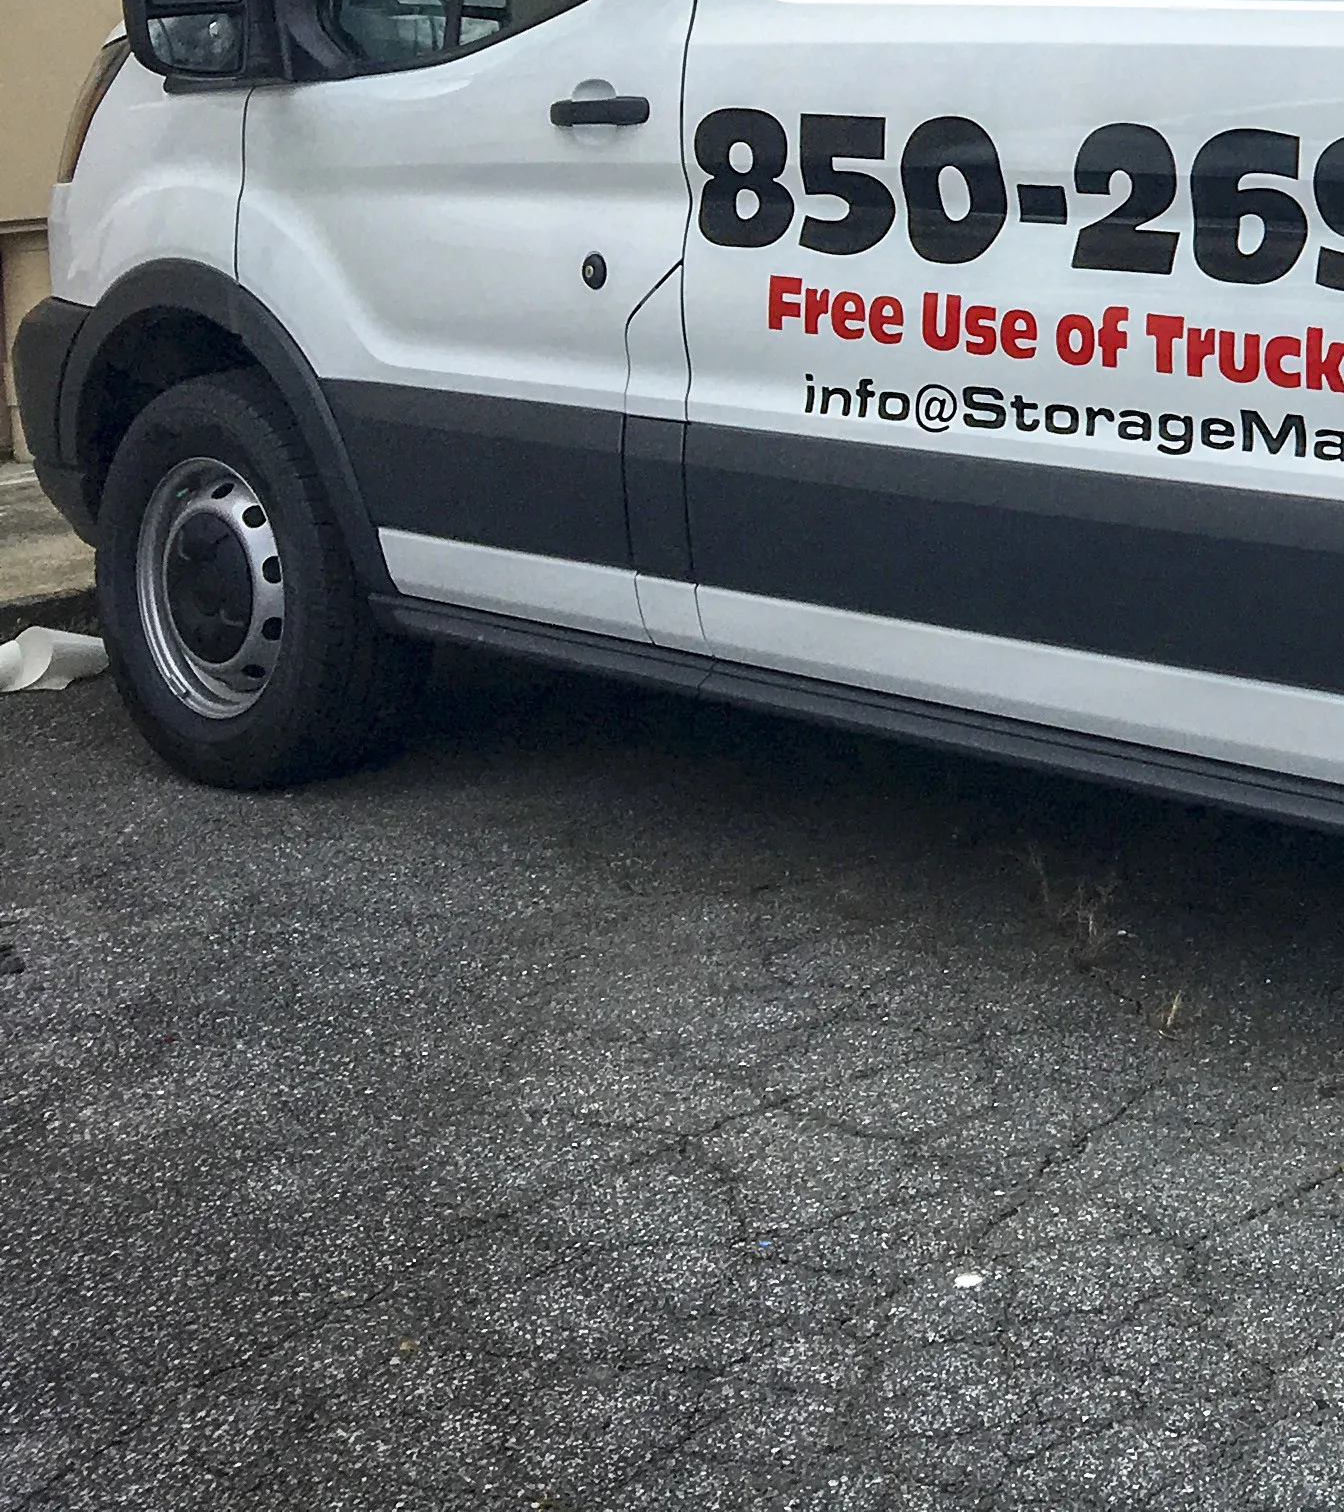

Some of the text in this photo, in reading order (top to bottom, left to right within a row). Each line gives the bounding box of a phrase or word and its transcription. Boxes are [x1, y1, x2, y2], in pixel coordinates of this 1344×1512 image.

[768, 274, 904, 345] Free
[922, 291, 1038, 359] Use
[1056, 306, 1129, 368] of
